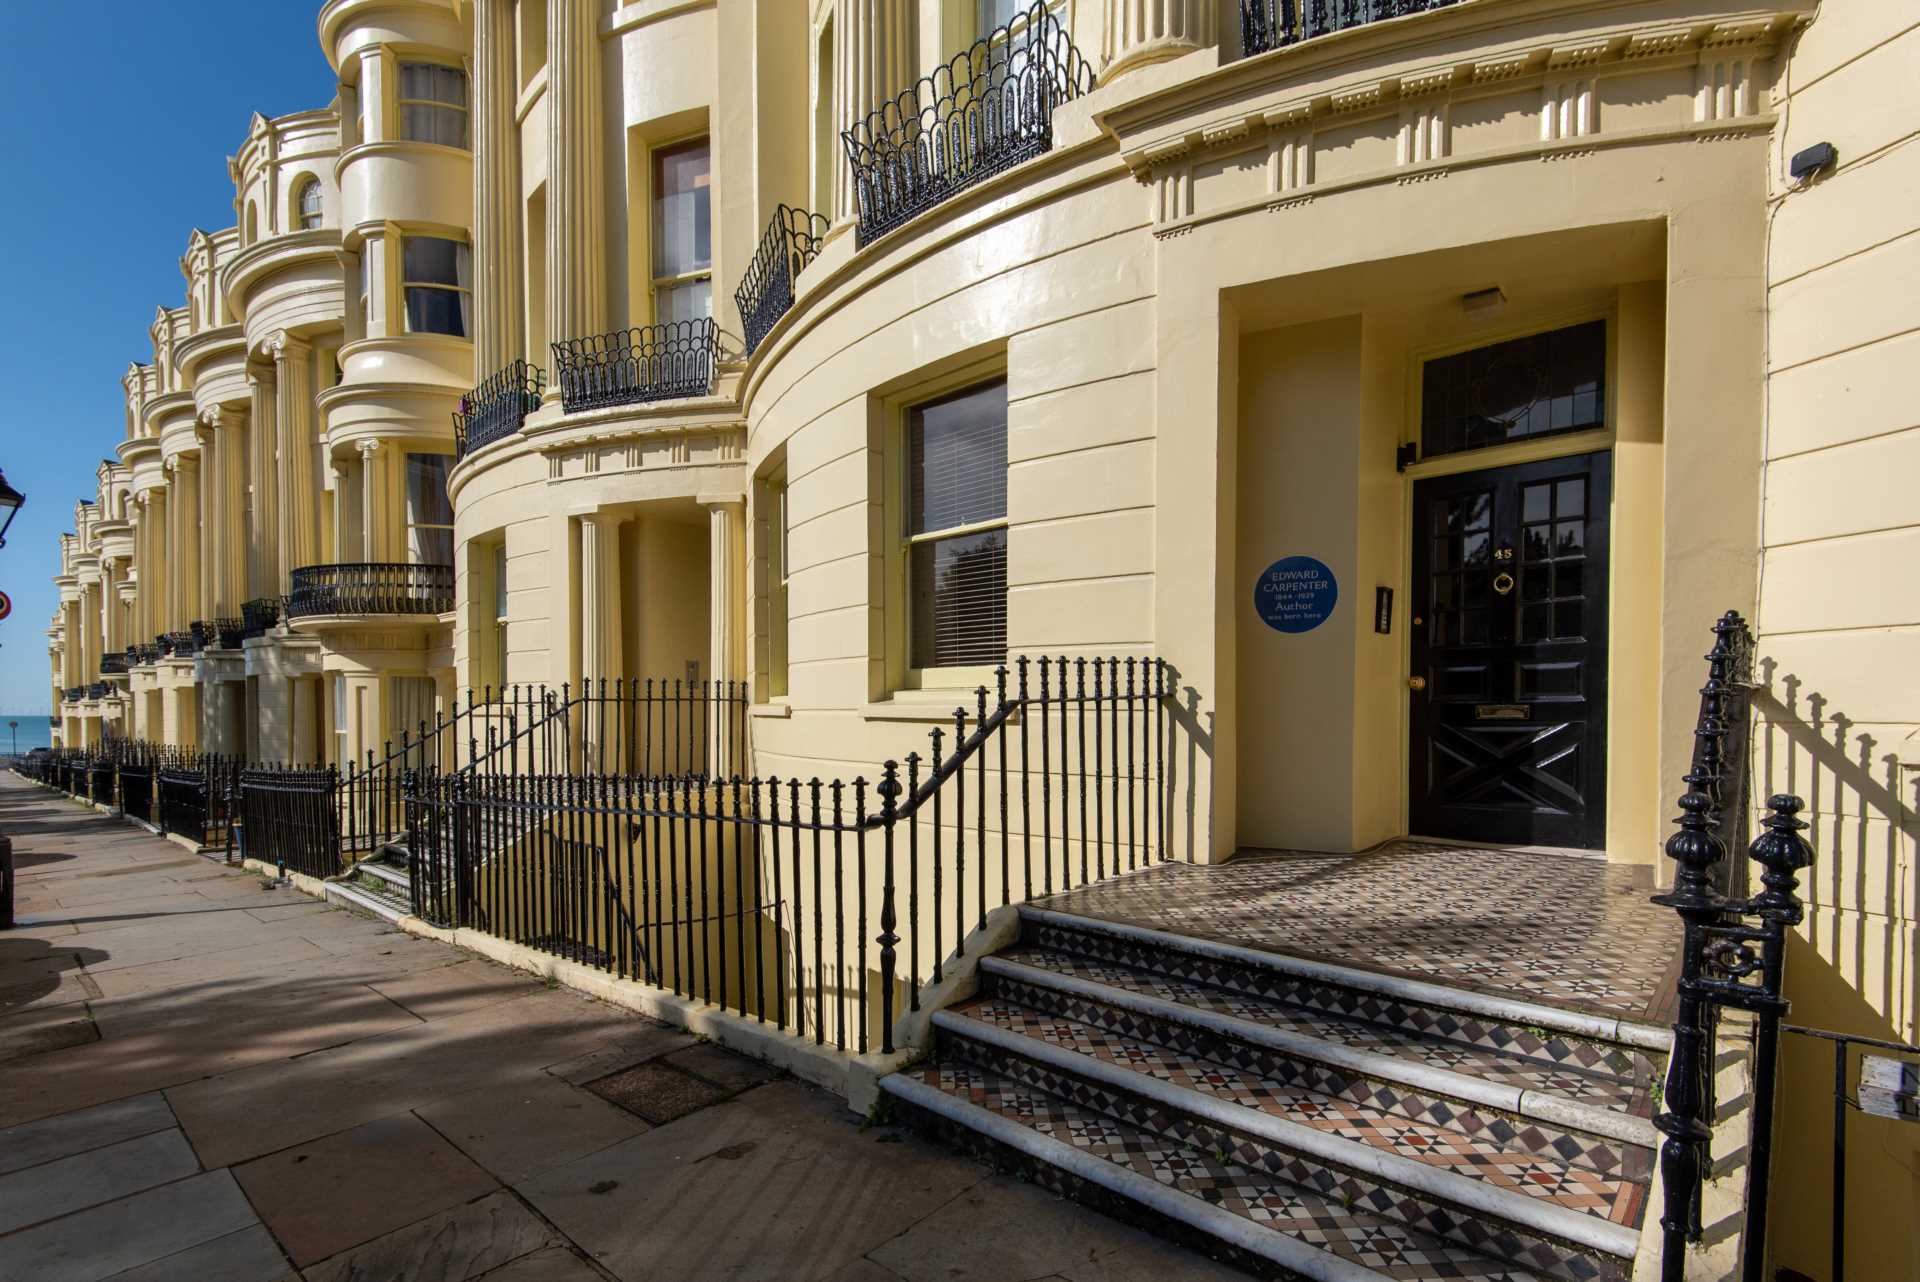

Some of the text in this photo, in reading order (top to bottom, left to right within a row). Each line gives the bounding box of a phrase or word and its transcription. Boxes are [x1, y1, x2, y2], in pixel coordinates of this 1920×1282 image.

[1495, 549, 1512, 560] 45
[1272, 571, 1319, 581] EDWARD
[1263, 581, 1328, 592] CARPENTER
[1276, 602, 1313, 611] Author
